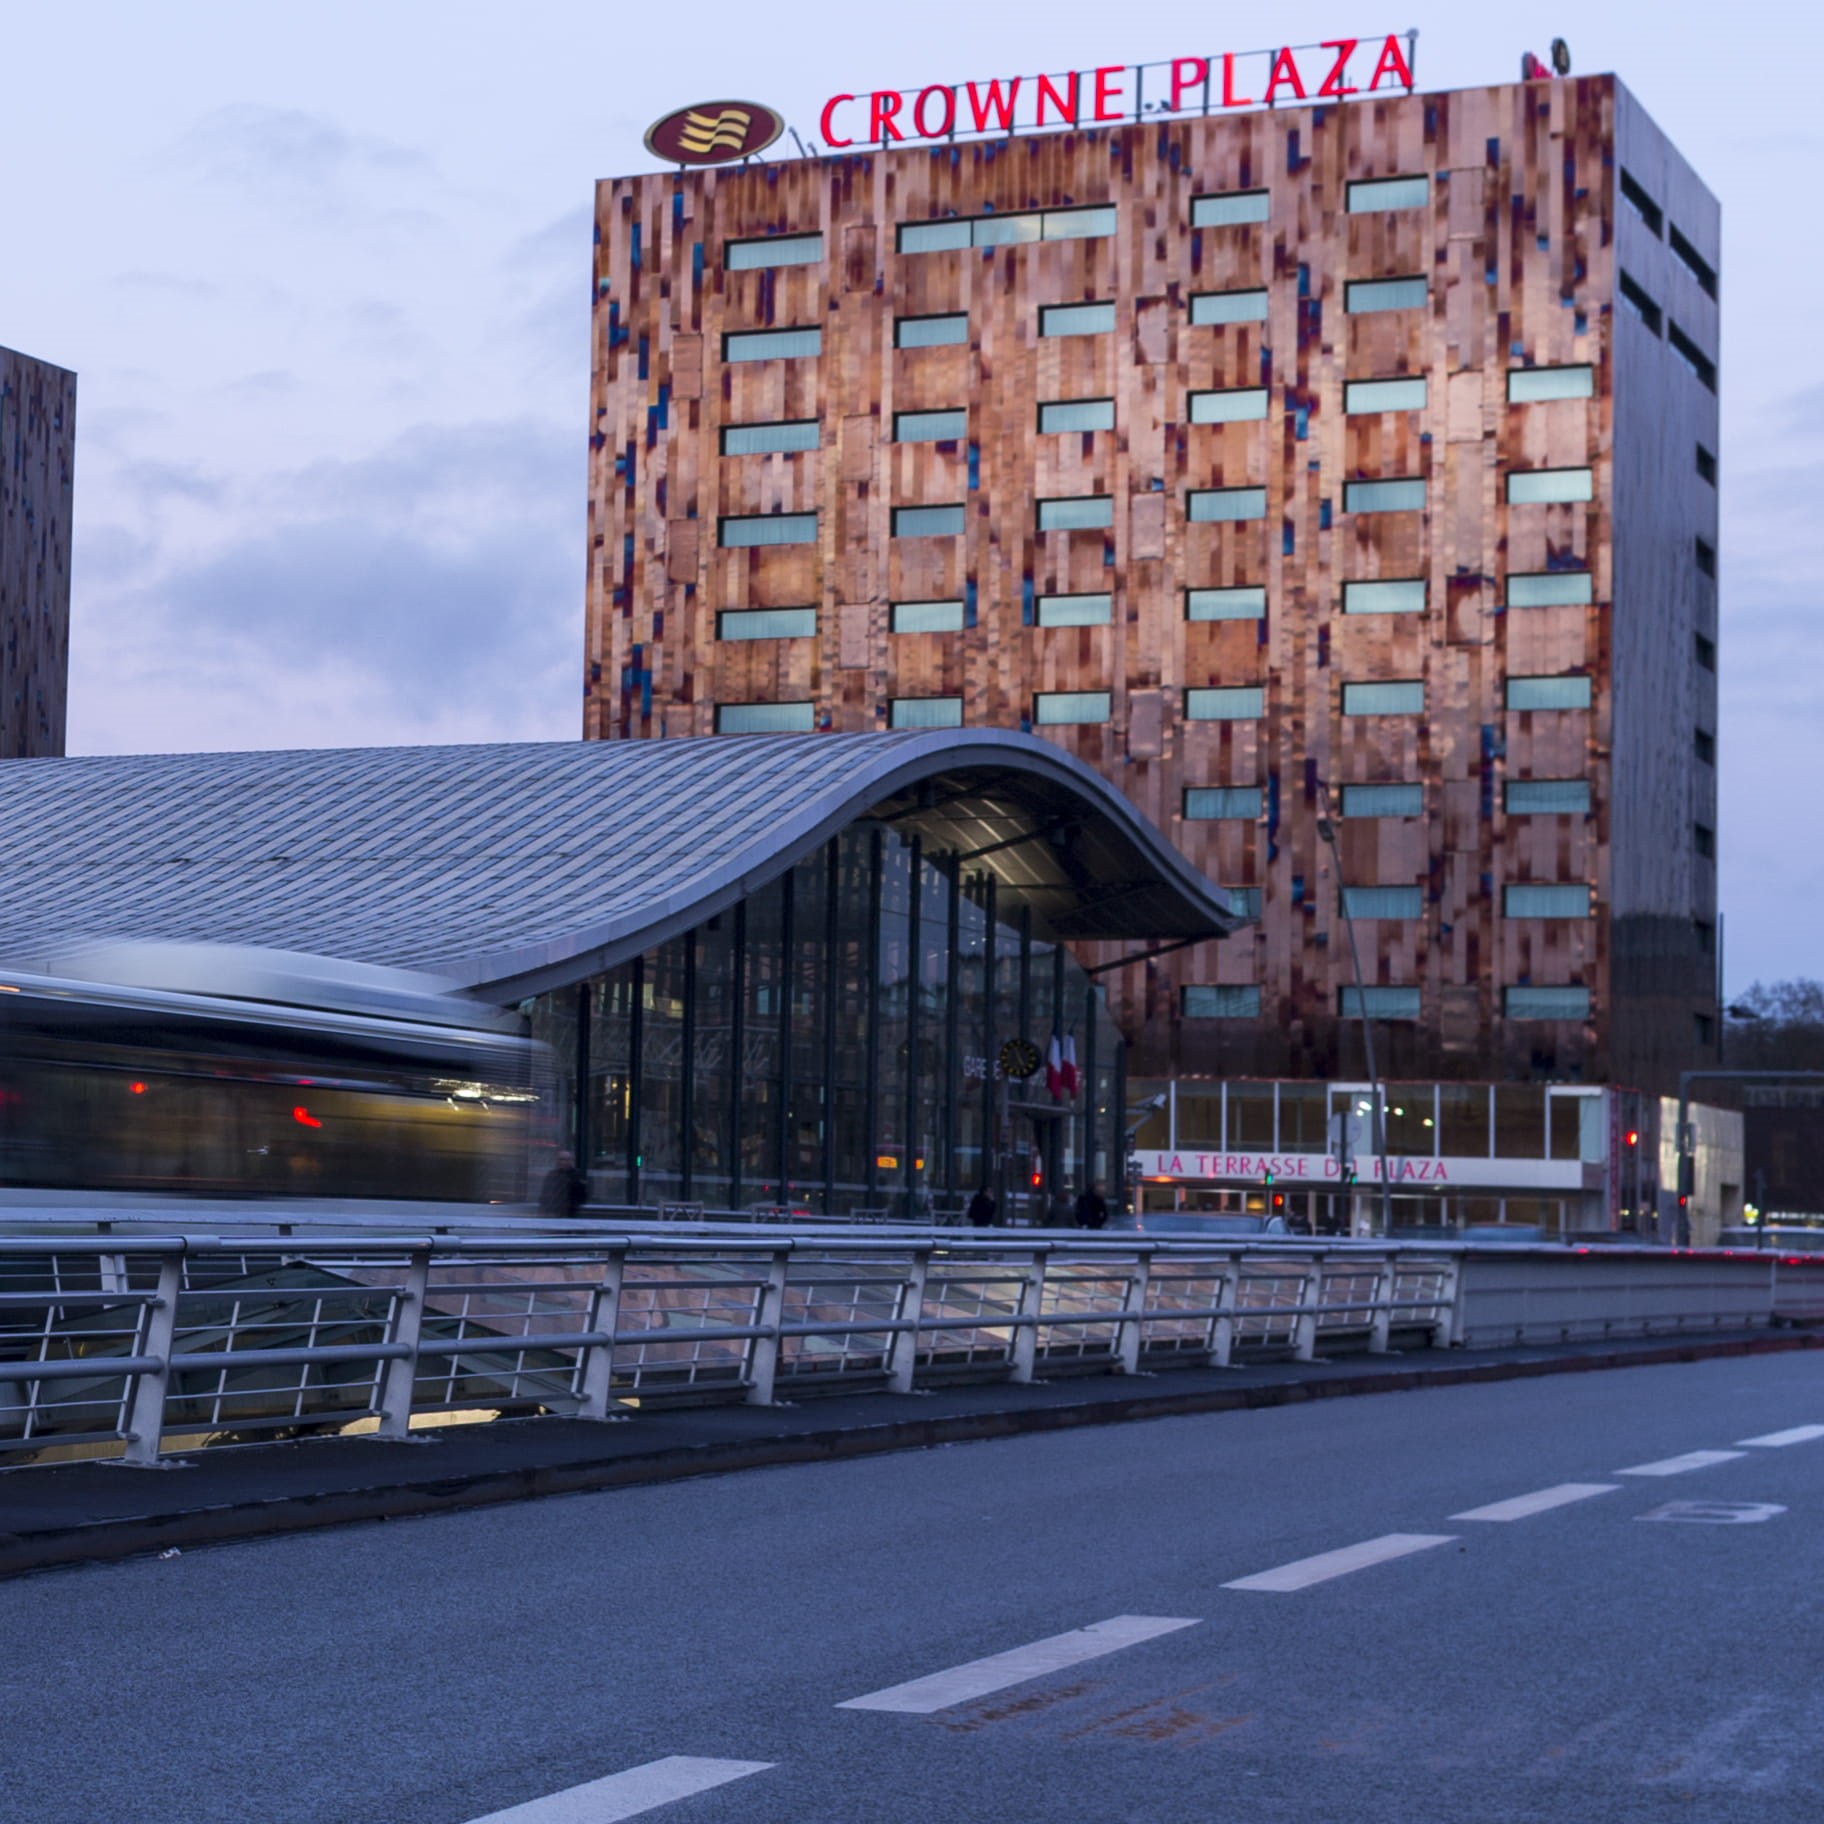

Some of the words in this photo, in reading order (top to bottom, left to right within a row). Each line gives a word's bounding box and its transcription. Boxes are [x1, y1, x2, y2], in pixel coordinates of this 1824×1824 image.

[820, 66, 1125, 148] CROWNE
[1171, 34, 1414, 111] PLAZA
[1157, 1154, 1183, 1174] LA
[1196, 1155, 1307, 1177] TERRASSE
